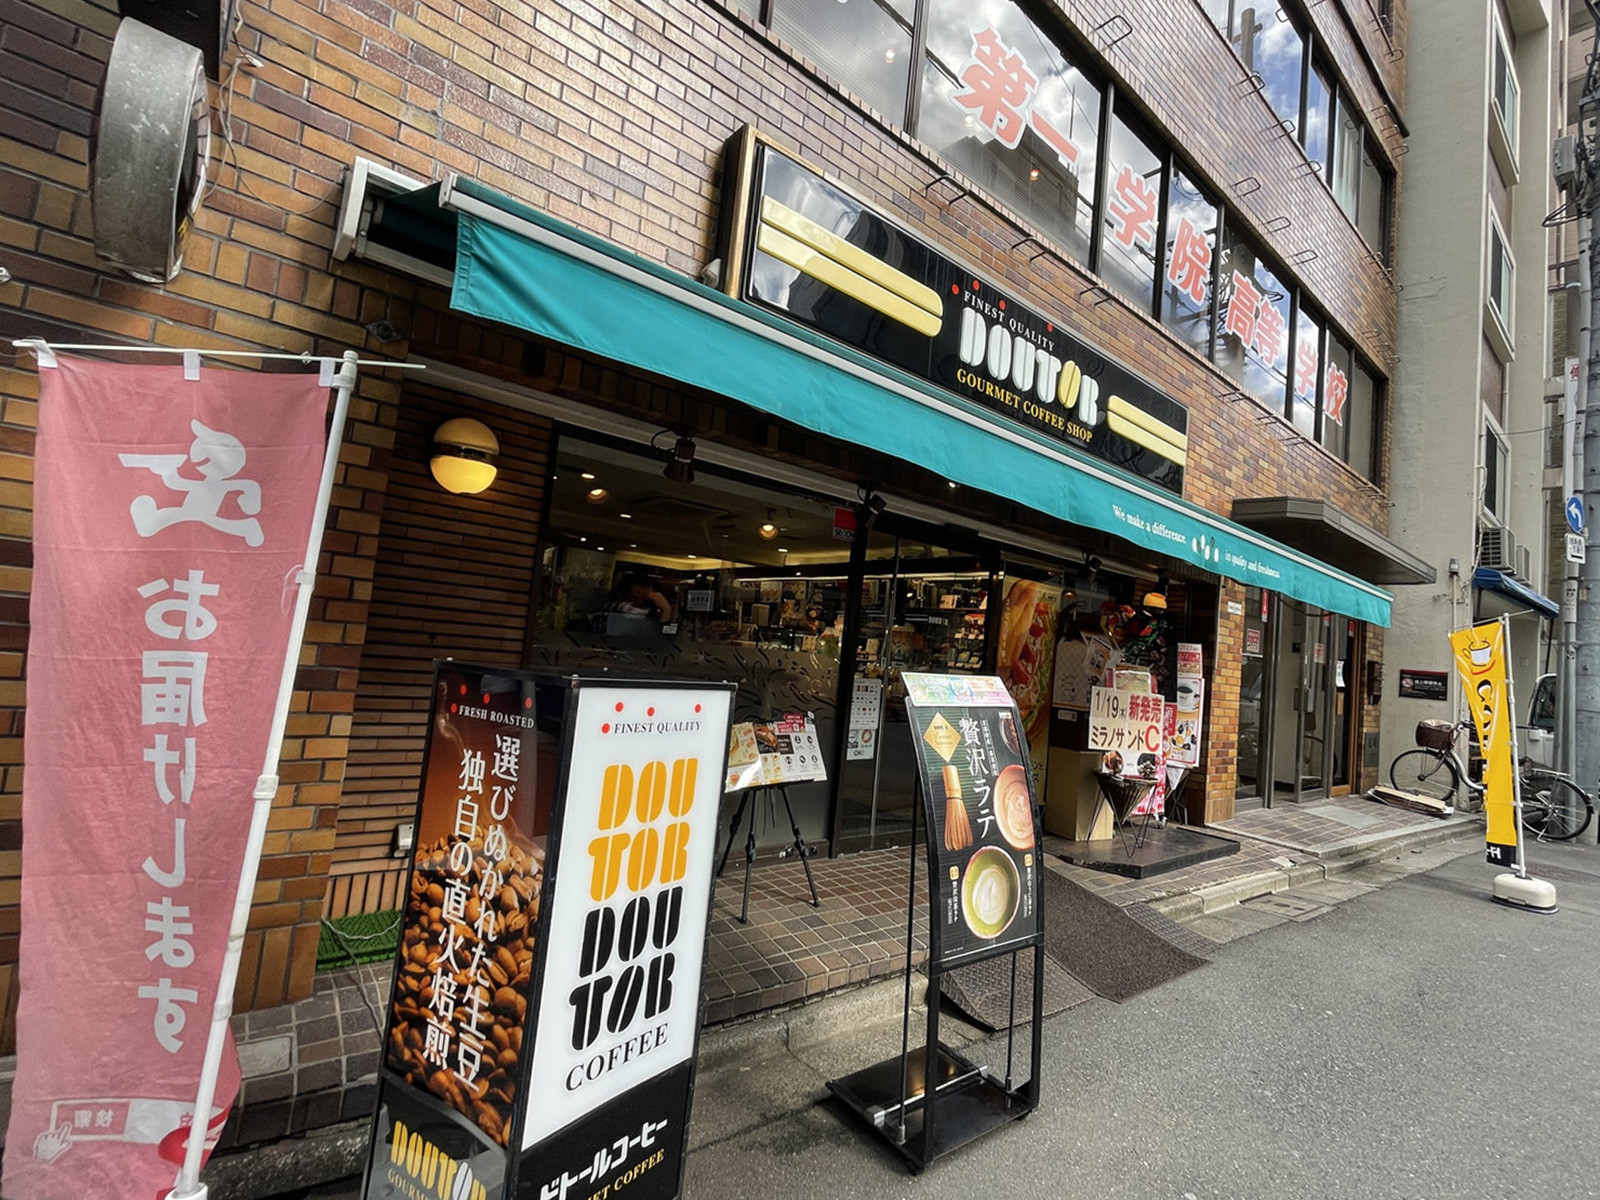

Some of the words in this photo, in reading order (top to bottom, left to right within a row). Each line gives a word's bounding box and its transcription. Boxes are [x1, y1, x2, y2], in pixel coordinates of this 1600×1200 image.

[963, 290, 1006, 323] FINEST
[1009, 318, 1056, 352] QUALITY
[959, 306, 1100, 427] DOUTOR
[956, 367, 1021, 409] GOURMET
[1022, 399, 1065, 432] COFFEE
[1066, 422, 1094, 444] SHOP
[1112, 504, 1126, 521] We
[1126, 514, 1145, 530] make
[1145, 522, 1151, 532] a
[1151, 521, 1187, 544] difference
[458, 704, 488, 721] FRESH
[490, 710, 535, 729] ROASTED
[613, 721, 655, 735] FINEST
[656, 720, 702, 734] QUALITY
[1128, 693, 1163, 724] 新発売
[597, 757, 699, 831] DOU
[958, 717, 995, 839] 贅沢ラテ
[588, 821, 691, 902] TOR
[422, 748, 486, 1070] 独自の直火焙煎
[452, 733, 522, 1092] 選びぬかれた生豆
[578, 885, 684, 979] DOU
[568, 952, 676, 1051] TOR
[565, 1023, 669, 1092] COFFEE
[613, 1148, 665, 1192] COFFEE
